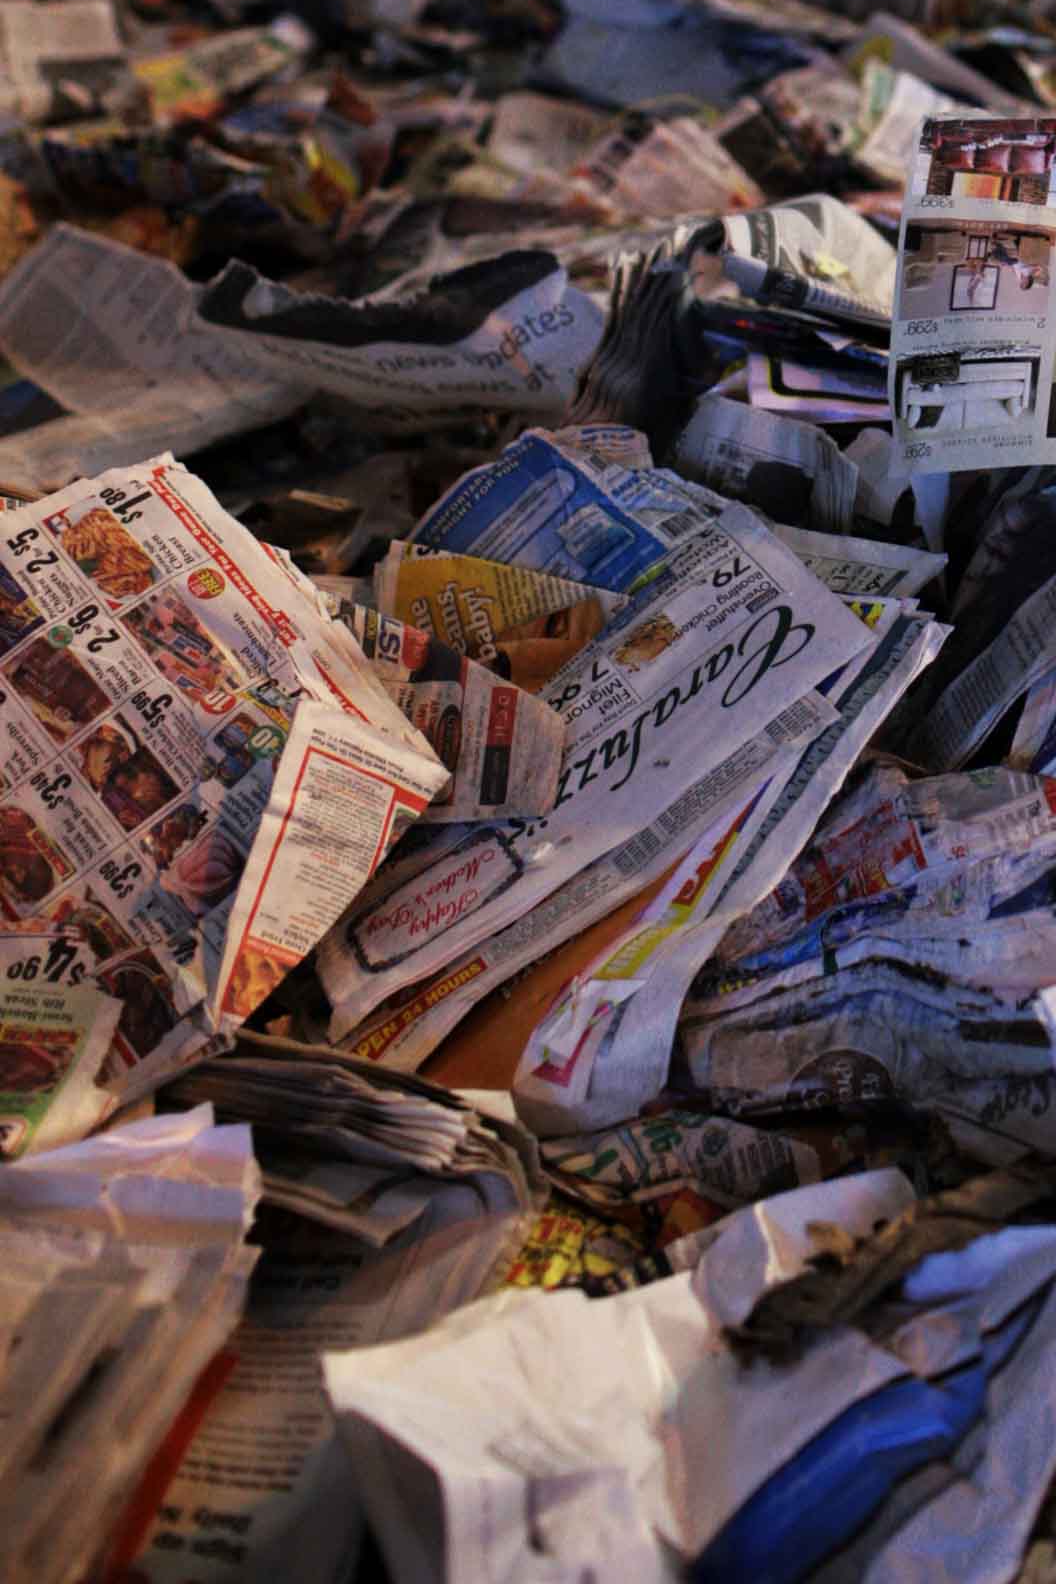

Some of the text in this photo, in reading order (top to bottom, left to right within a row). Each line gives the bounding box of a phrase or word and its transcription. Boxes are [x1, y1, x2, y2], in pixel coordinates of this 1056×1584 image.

[23, 545, 60, 579] 2
[149, 531, 184, 571] Chicken
[714, 568, 765, 608] Roasting
[84, 624, 121, 658] 2
[595, 685, 632, 717] Filet
[402, 882, 485, 944] Happy
[421, 959, 484, 1006] HOURS
